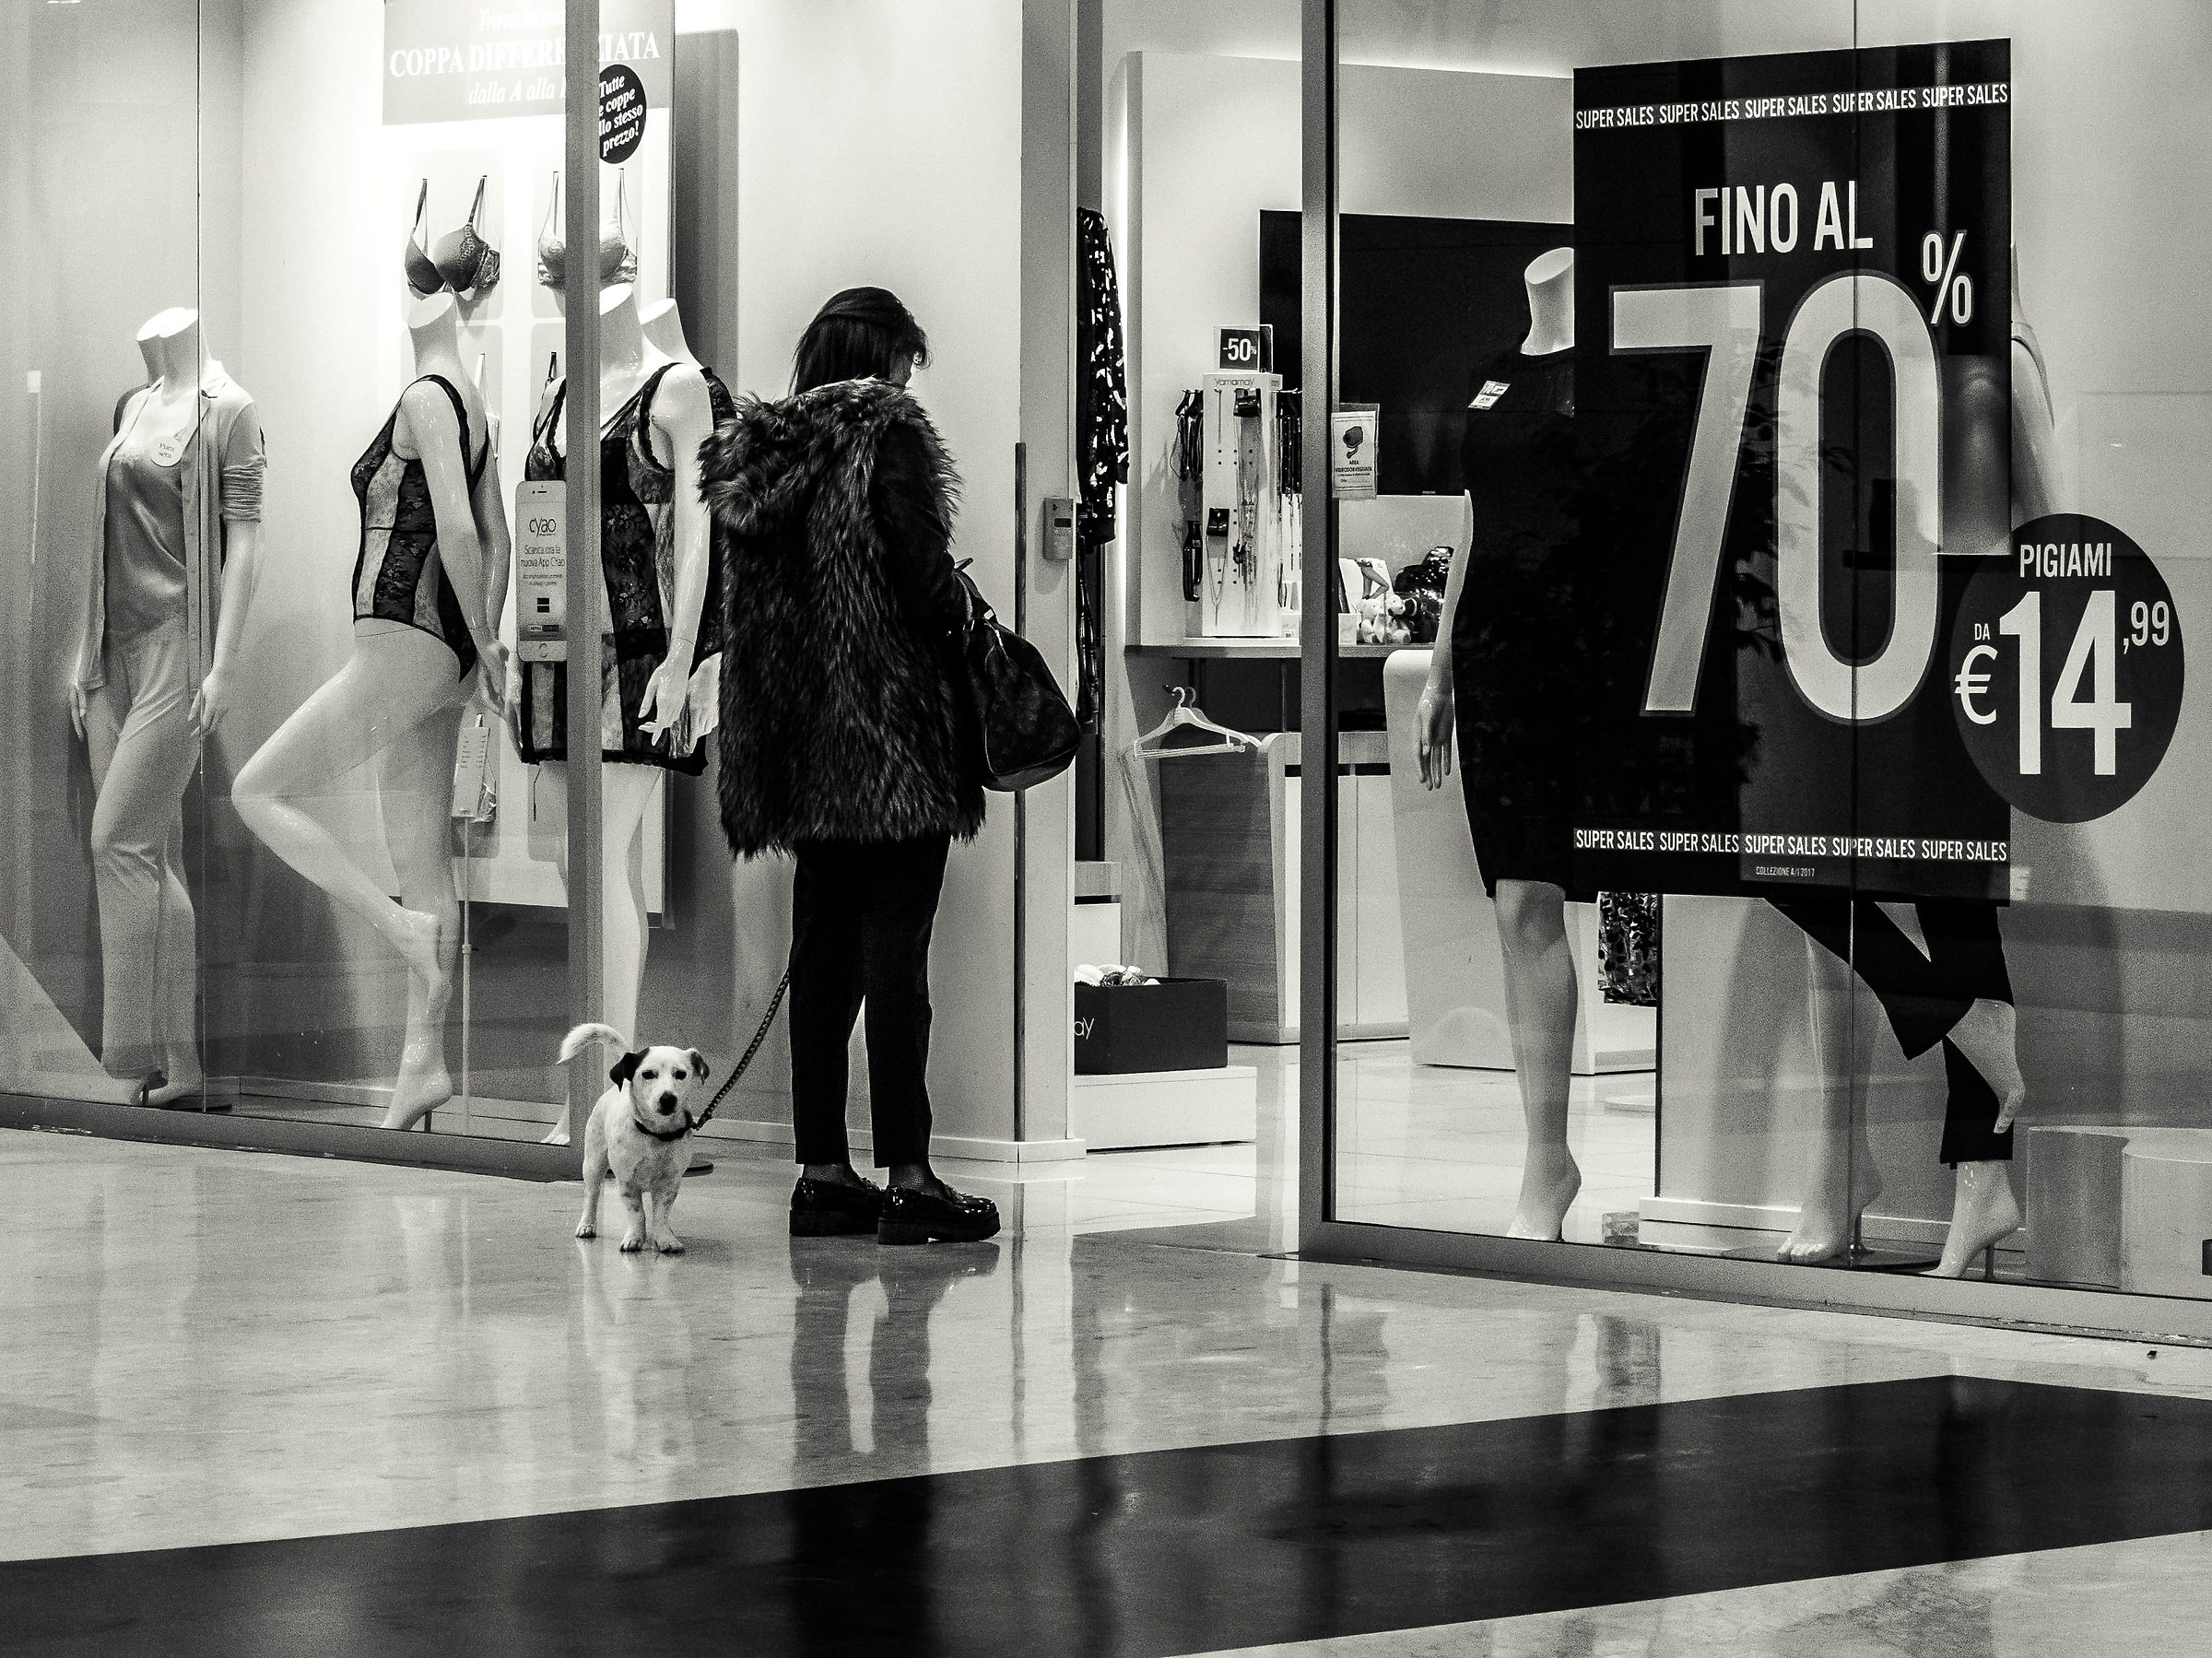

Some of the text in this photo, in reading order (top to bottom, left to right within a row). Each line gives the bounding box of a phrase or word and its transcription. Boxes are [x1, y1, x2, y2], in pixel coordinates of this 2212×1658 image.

[390, 31, 660, 76] COPPA DIFFEREIATA
[468, 80, 506, 105] dalla
[508, 79, 523, 102] A
[525, 76, 556, 100] alla
[599, 75, 626, 99] Tutte
[606, 88, 636, 113] coppe
[599, 104, 643, 136] llo stesso
[1576, 109, 1614, 129] SUPER
[1617, 106, 1654, 127] SALES
[1659, 103, 1698, 124] SUPER
[1701, 100, 1740, 122] SALES
[1745, 98, 1785, 119] SUPER
[1788, 95, 1828, 116] SALES
[1877, 89, 1917, 111] SALES
[1922, 86, 1964, 108] SUPER
[1967, 84, 2008, 105] SALES
[602, 120, 639, 158] prezzo!
[1695, 180, 1875, 256] FINO AL
[529, 517, 557, 537] cyao
[2019, 543, 2112, 578] PIGIAMI
[1974, 623, 1991, 641] DA
[1576, 829, 2007, 862] SUPER SALES SUPER SALES SUPER SALES SUPER SALES SUPER SALES
[1756, 865, 1789, 876] COLLEZIONE
[1800, 867, 1816, 877] 2017
